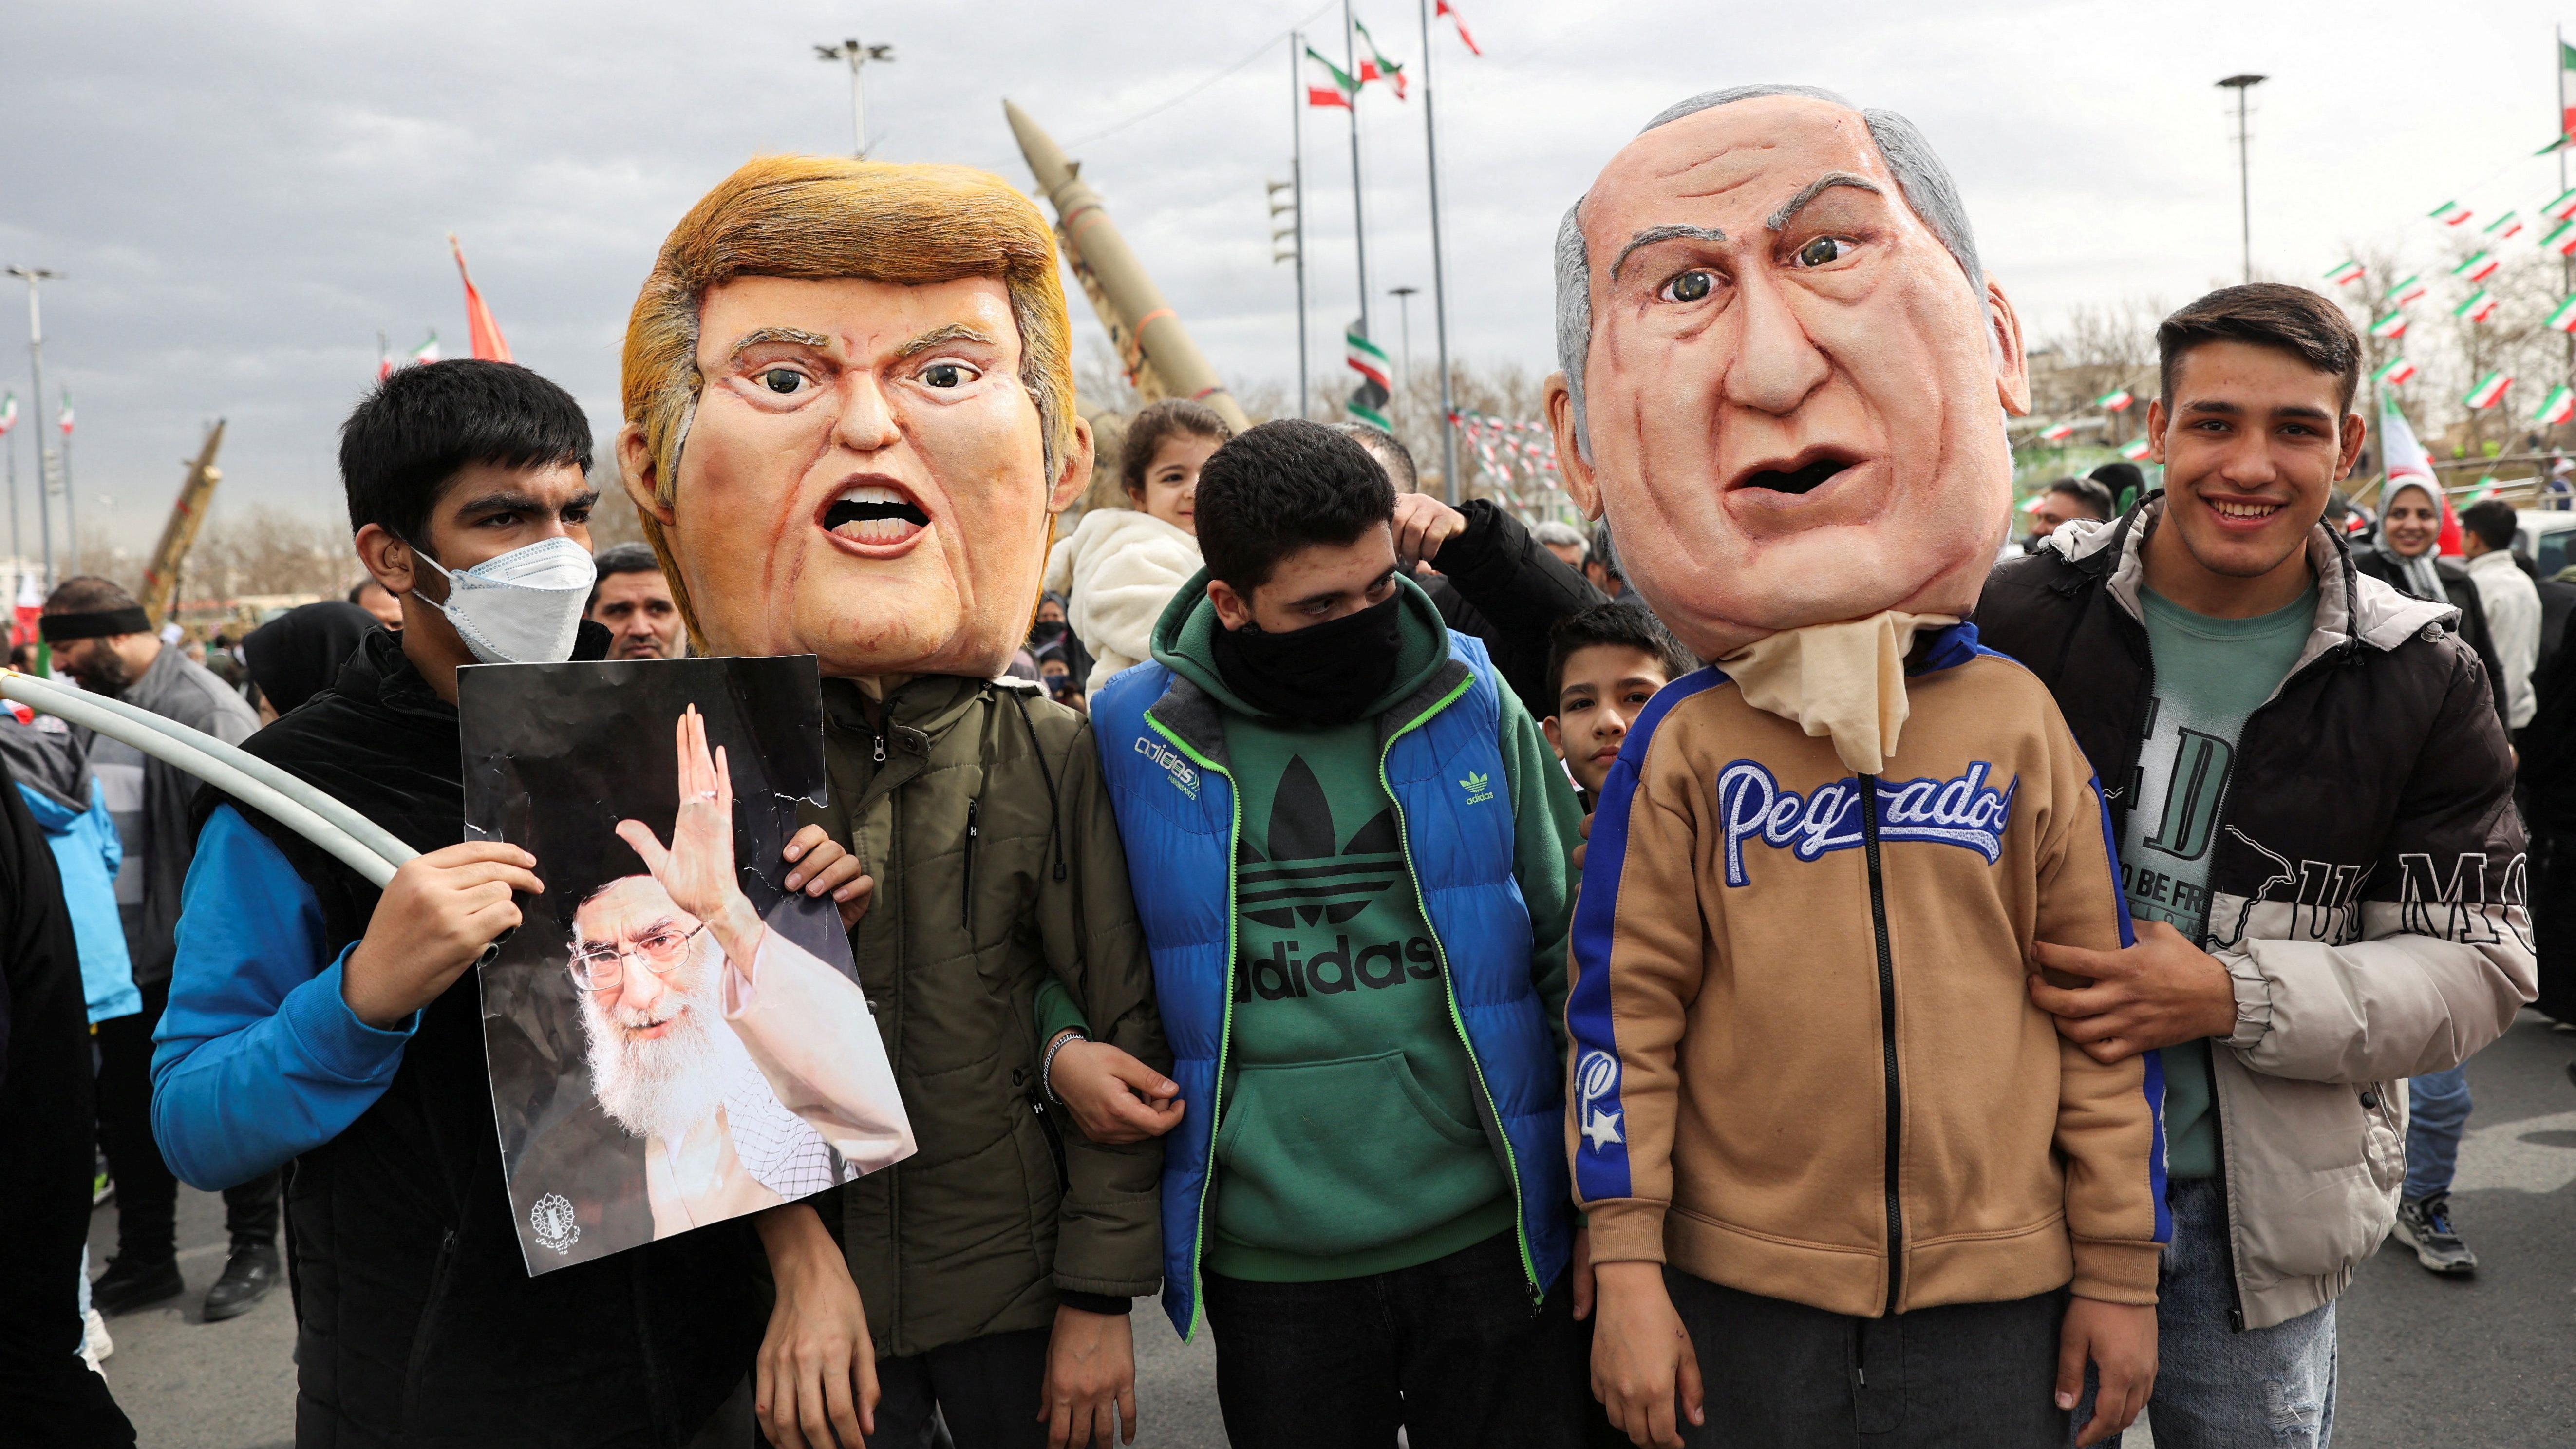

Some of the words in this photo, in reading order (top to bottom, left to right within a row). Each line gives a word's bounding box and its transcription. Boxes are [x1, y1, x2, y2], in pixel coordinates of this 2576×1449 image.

[1134, 737, 1195, 784] adidas
[1466, 792, 1494, 805] adidas
[2118, 861, 2133, 890] O
[2136, 868, 2170, 903] BE
